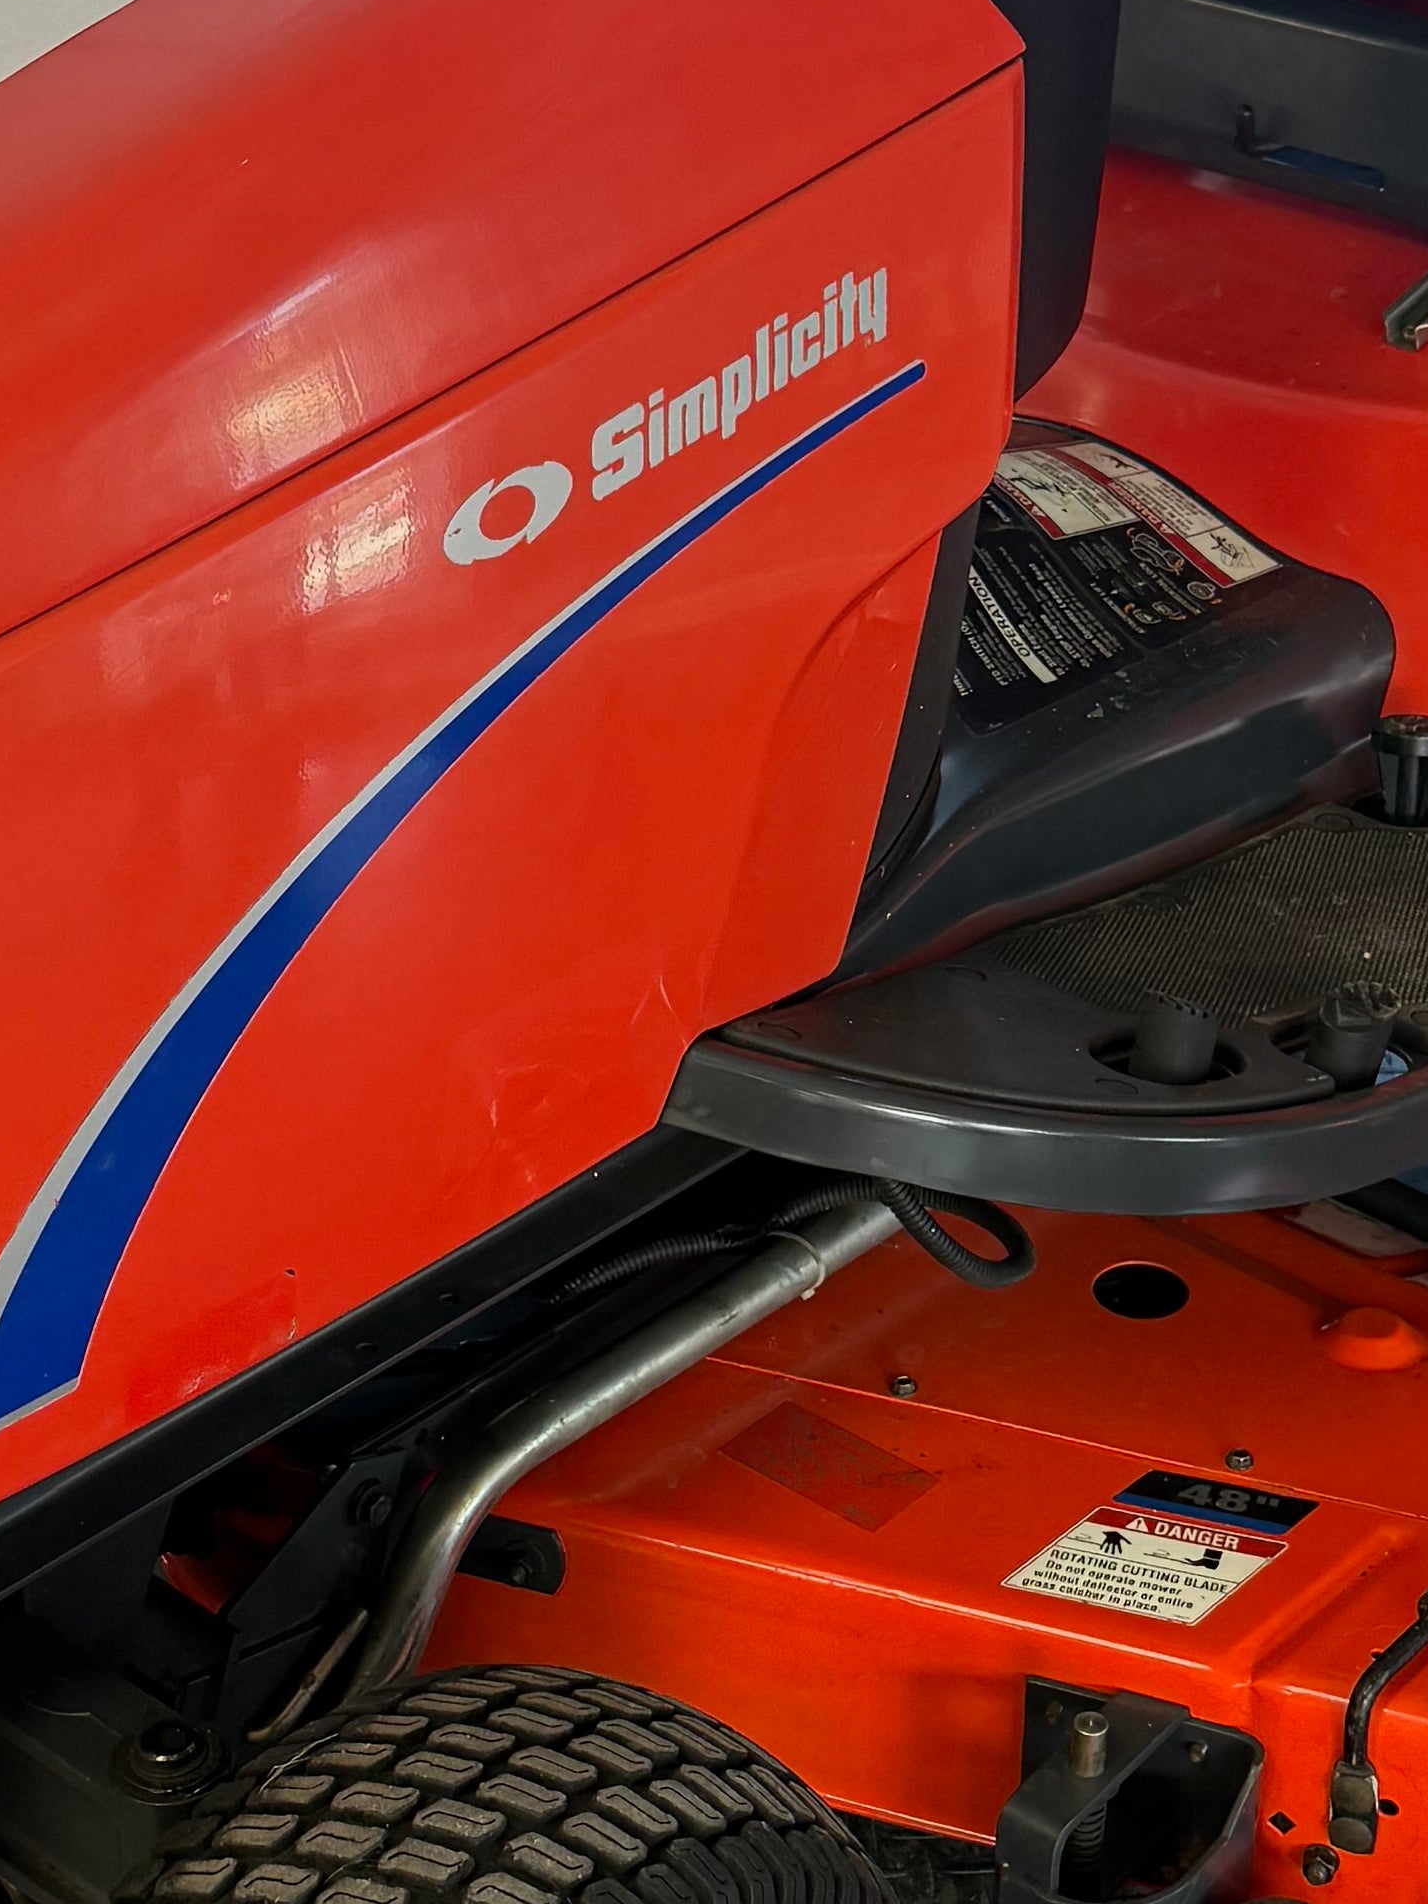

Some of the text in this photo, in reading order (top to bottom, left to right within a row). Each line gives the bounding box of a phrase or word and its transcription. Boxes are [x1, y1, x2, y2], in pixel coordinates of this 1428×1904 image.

[592, 268, 887, 501] Simplicity
[969, 576, 1030, 658] OPERATION
[1177, 1483, 1280, 1513] 48"
[1154, 1521, 1240, 1551] DANGER
[1034, 1570, 1194, 1609] without deflector or entire
[1045, 1559, 1183, 1596] Do not operate mower
[1050, 1549, 1228, 1594] ROTATING CUTTING BLADE
[1022, 1578, 1056, 1591] grass
[1108, 1594, 1121, 1604] in
